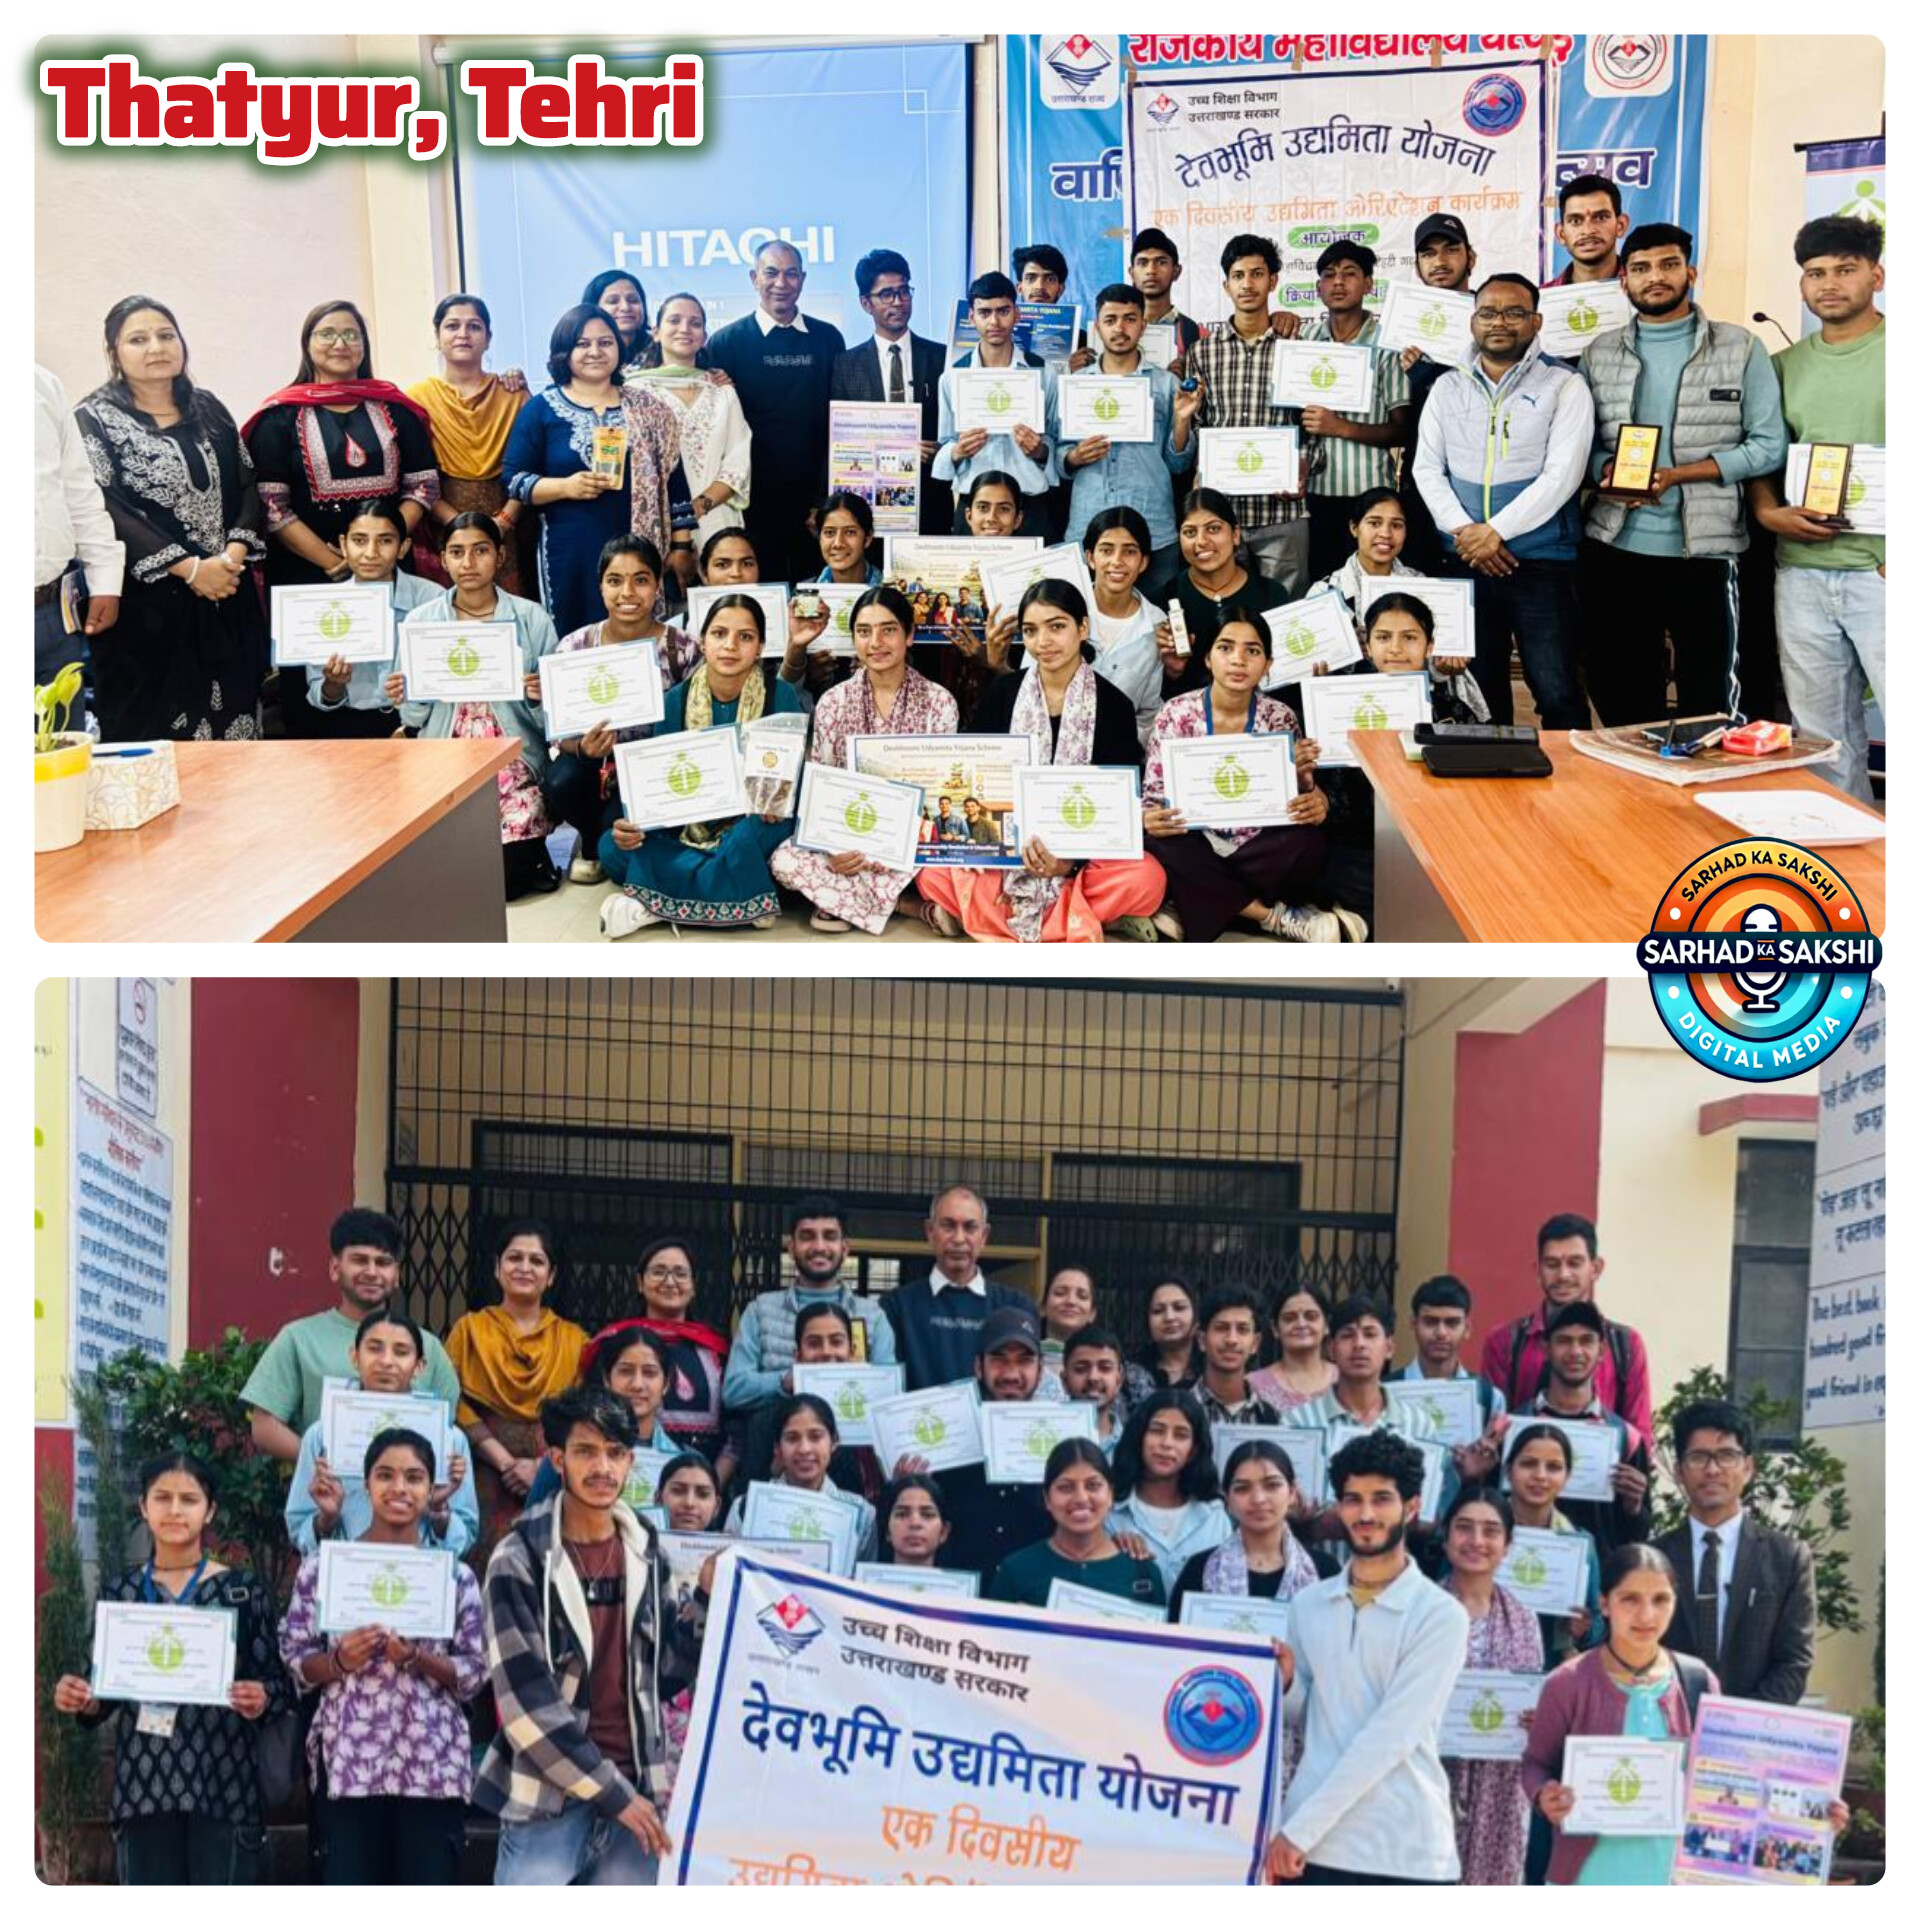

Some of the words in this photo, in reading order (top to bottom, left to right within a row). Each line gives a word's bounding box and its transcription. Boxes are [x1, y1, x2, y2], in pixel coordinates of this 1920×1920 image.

[1213, 92, 1241, 105] शिक्षा
[1243, 90, 1279, 103] विभाग
[1243, 107, 1281, 120] सरकार
[1174, 126, 1275, 189] देवभूमि
[1282, 114, 1393, 158] उद्यमिता
[1401, 119, 1498, 177] योजना
[612, 225, 835, 268] HITACHI
[841, 1615, 889, 1641] उच्च
[895, 1624, 952, 1656] शिक्षा
[957, 1639, 1030, 1674] विभाग
[840, 1645, 949, 1685] उत्तराखण्ड
[953, 1668, 1030, 1703] सरकार
[741, 1681, 901, 1776] देवभूमि
[911, 1731, 1086, 1801] उद्यमिता
[1096, 1753, 1241, 1826] योजना
[881, 1805, 938, 1851] एक
[947, 1803, 1083, 1872] दिवसीय
